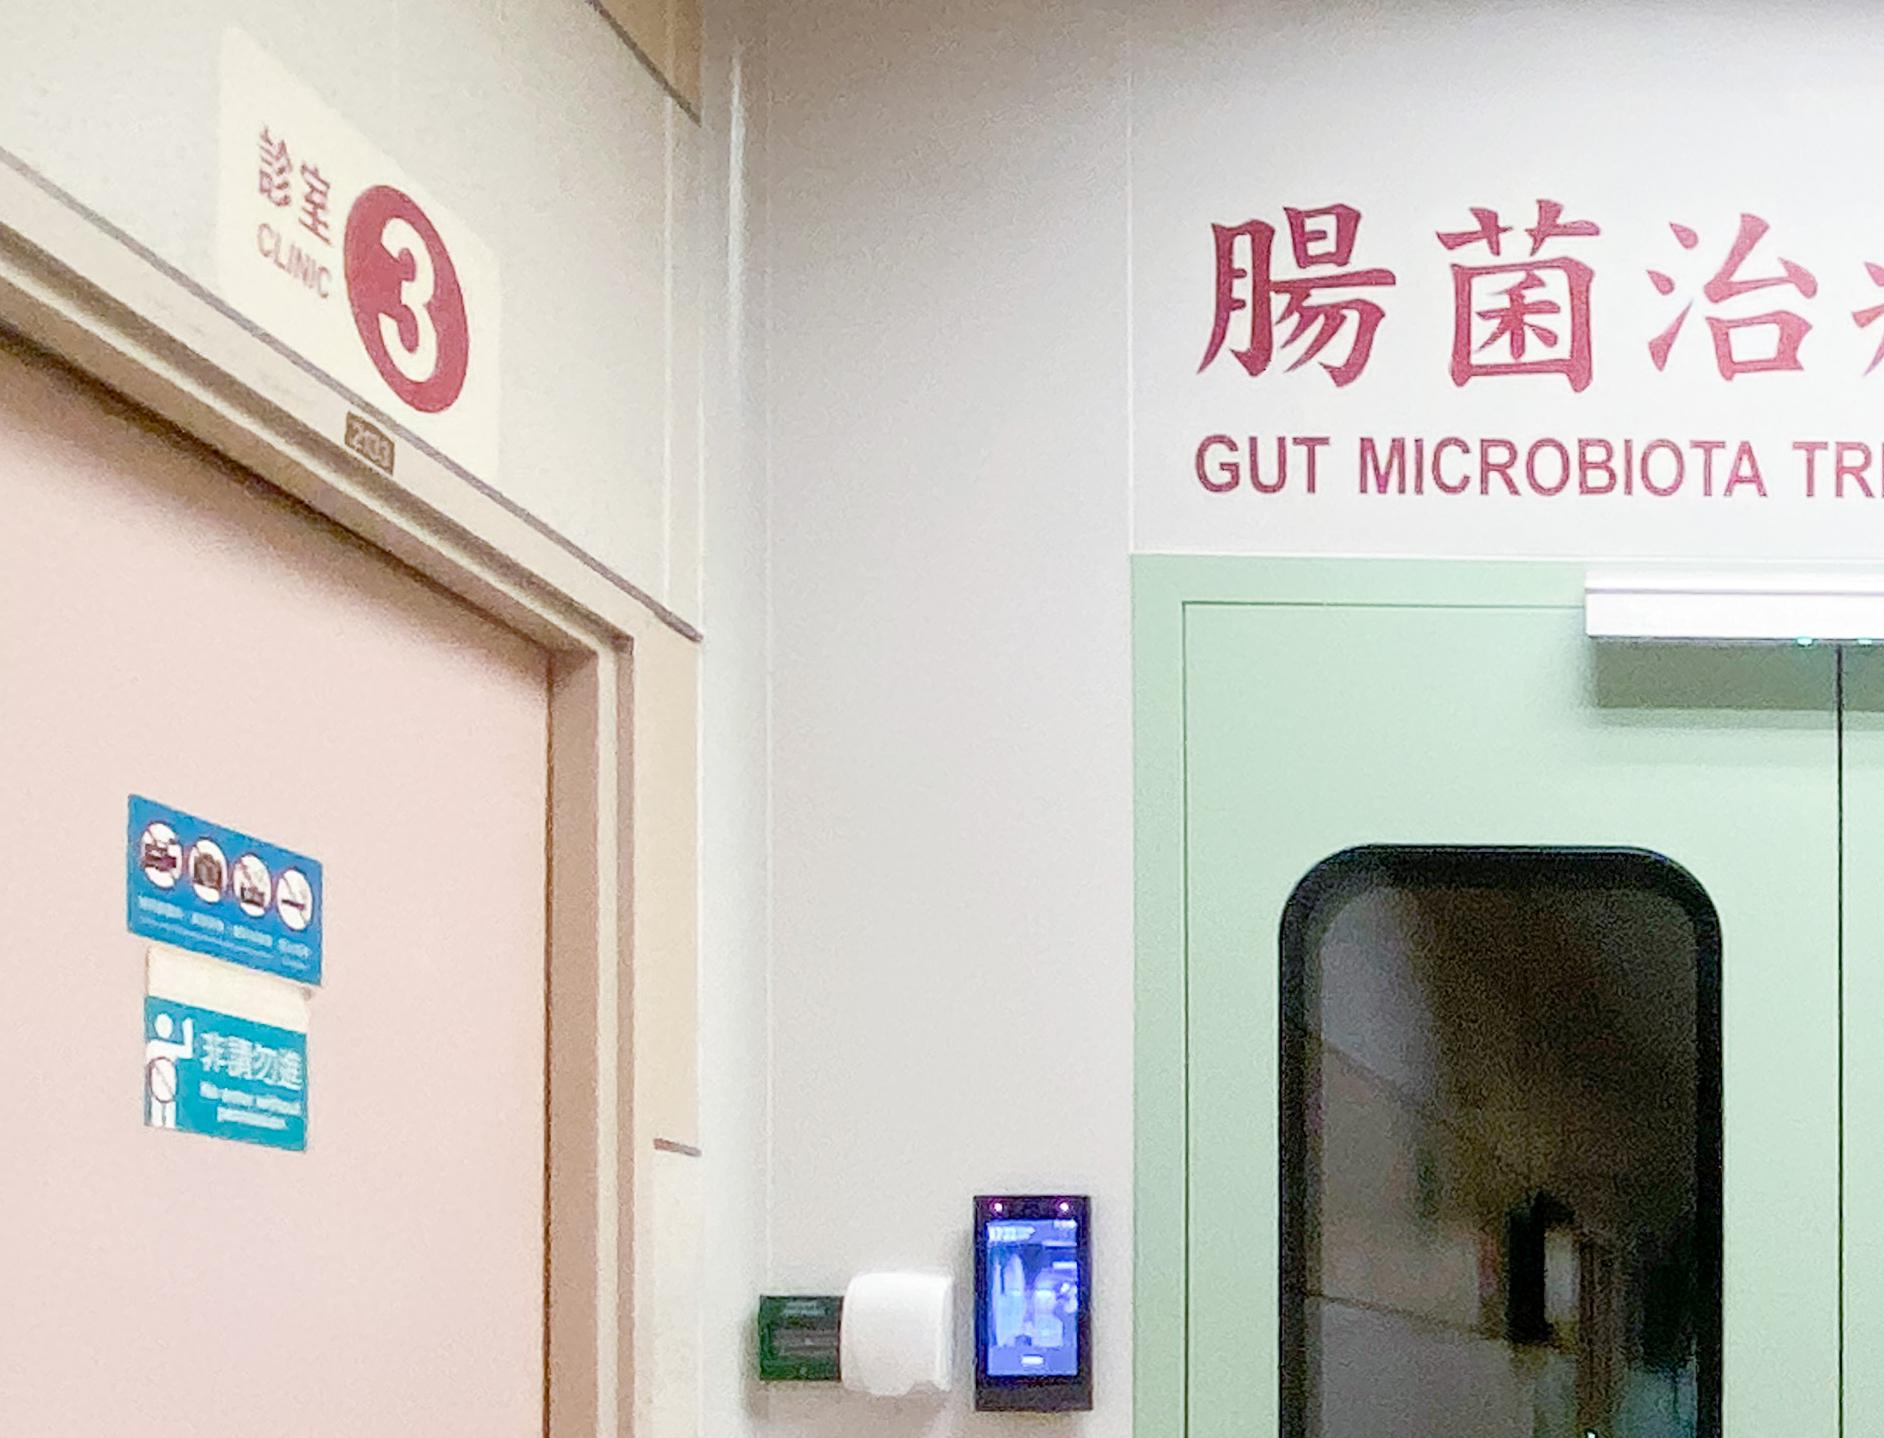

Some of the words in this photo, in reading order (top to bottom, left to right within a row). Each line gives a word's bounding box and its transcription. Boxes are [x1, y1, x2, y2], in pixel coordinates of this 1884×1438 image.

[258, 124, 333, 247] 診室
[256, 222, 331, 300] CLINIC
[380, 216, 438, 383] 3
[1195, 434, 1331, 496] GUT
[1358, 436, 1769, 498] MICROBIOTA
